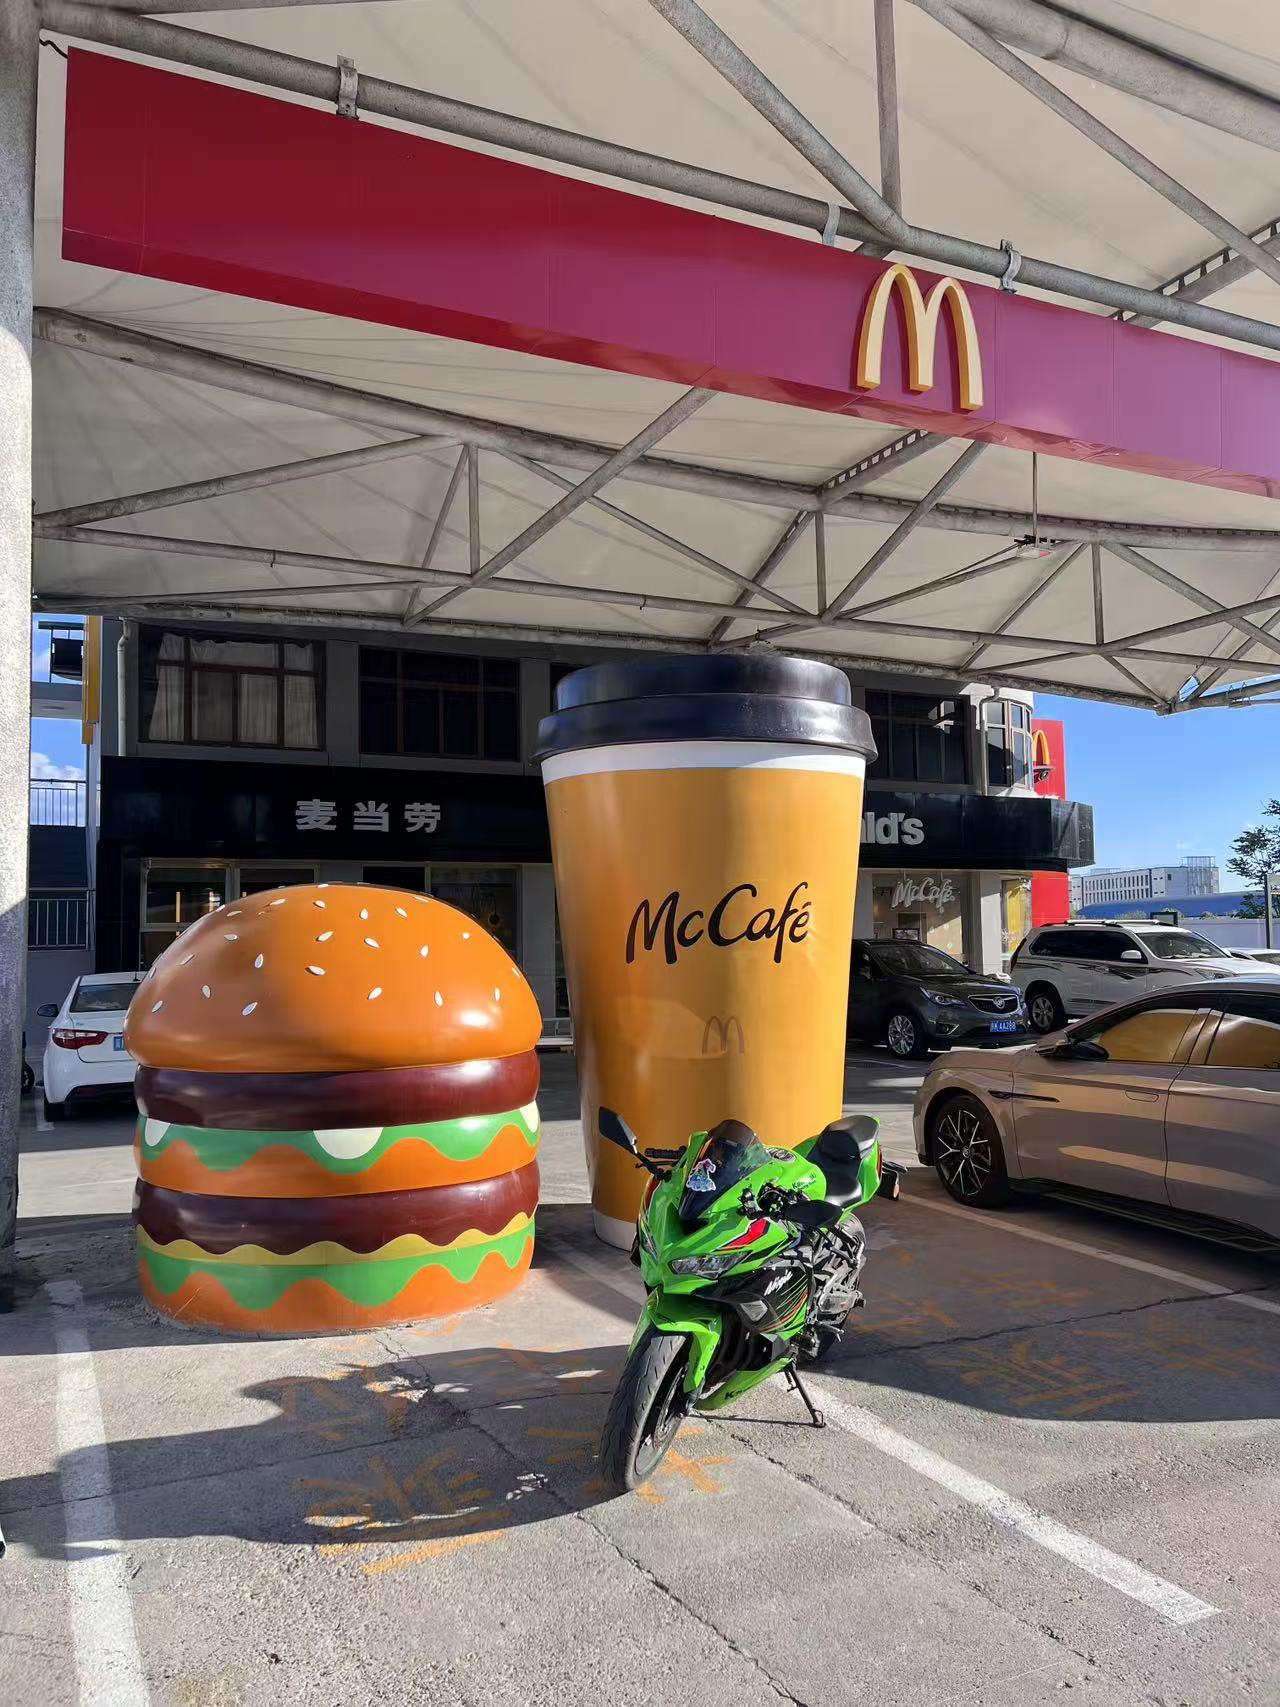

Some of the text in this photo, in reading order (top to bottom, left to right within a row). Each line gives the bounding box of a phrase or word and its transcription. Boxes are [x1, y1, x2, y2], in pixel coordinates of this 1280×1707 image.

[295, 798, 441, 833] 麦当劳
[891, 876, 955, 913] McCafé
[626, 881, 812, 965] McCafé
